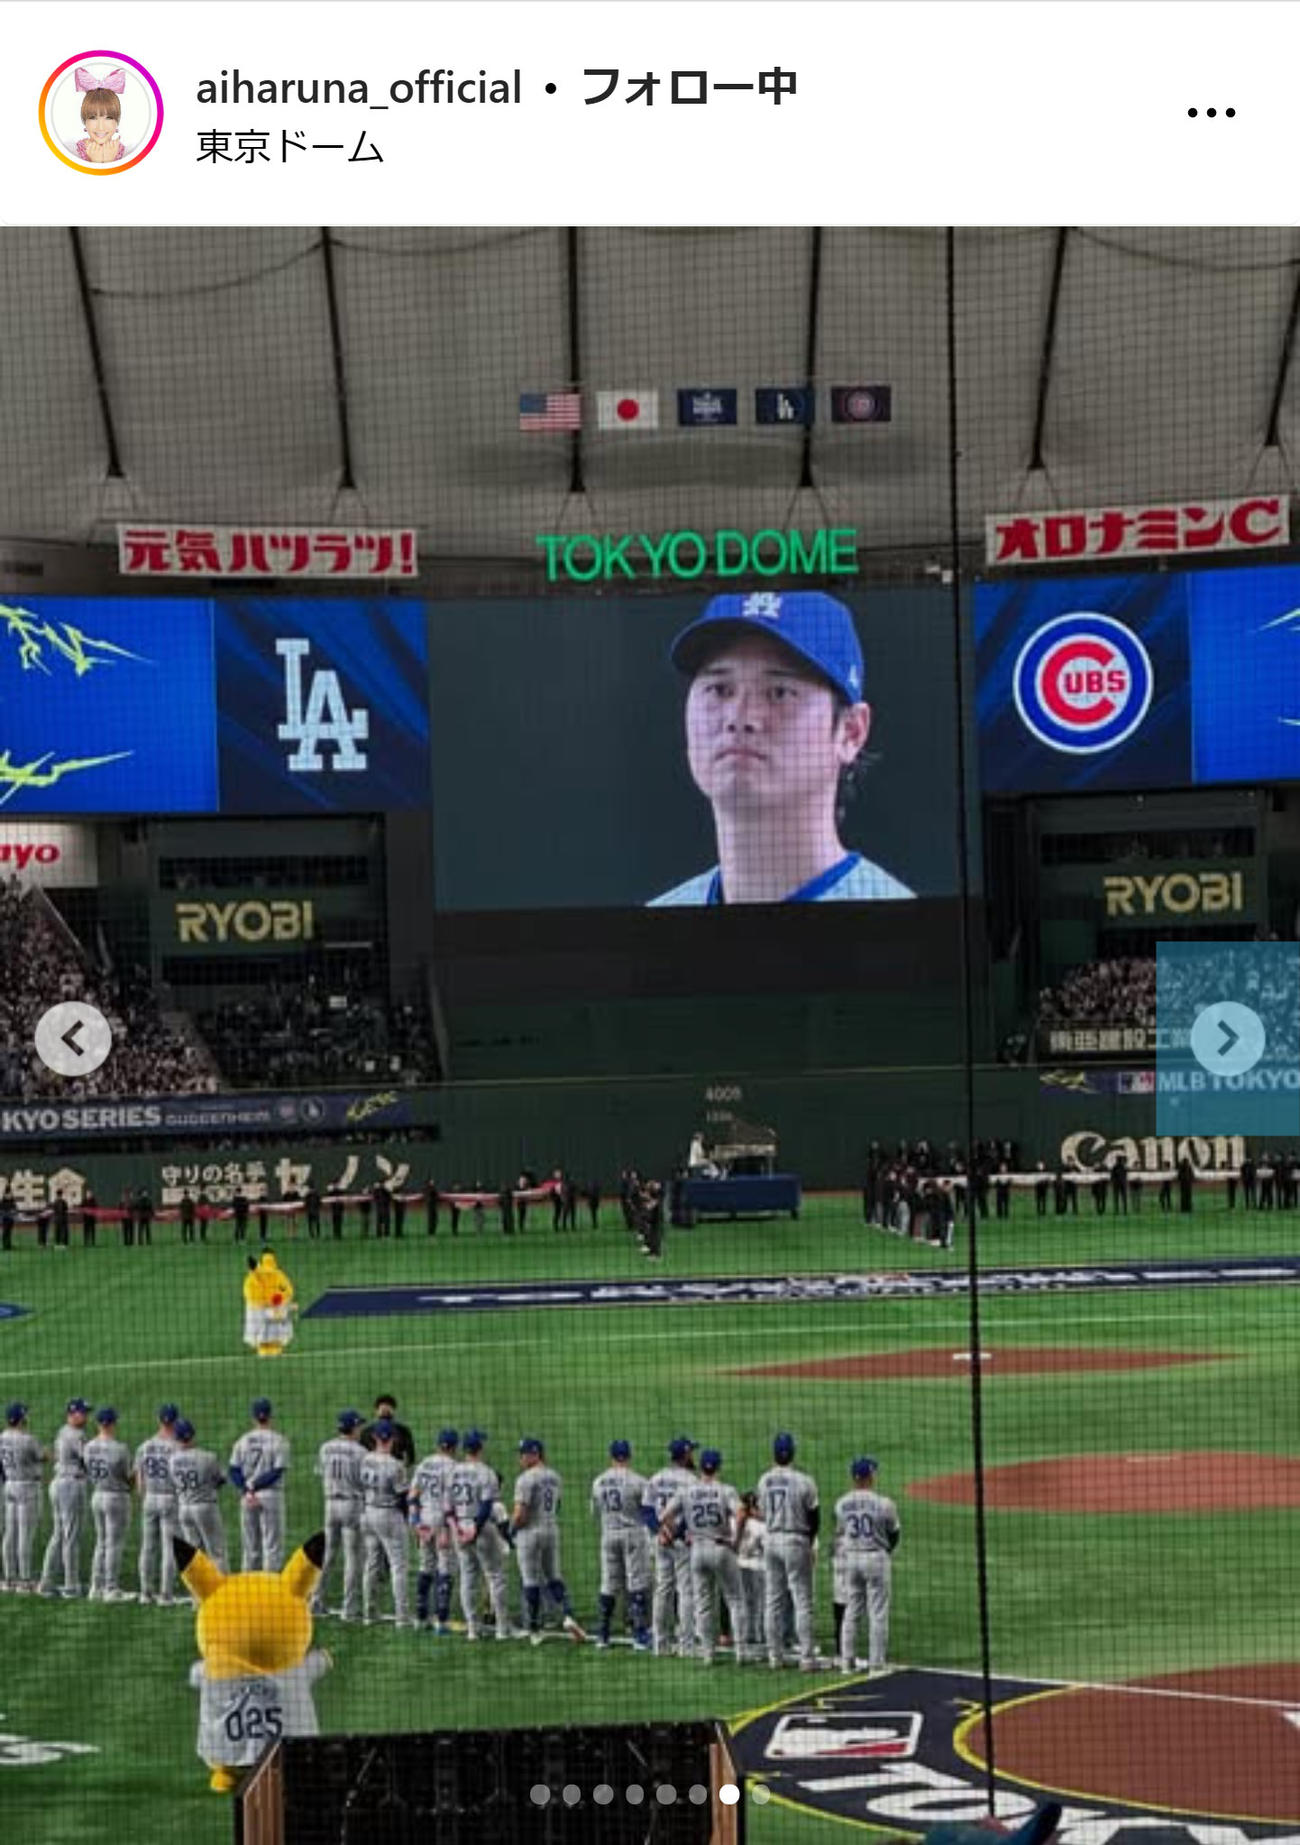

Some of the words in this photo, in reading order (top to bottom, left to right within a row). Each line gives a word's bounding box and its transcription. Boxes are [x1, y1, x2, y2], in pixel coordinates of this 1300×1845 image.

[996, 499, 1282, 560] オロナミンC
[123, 529, 414, 574] 元気ハツラツ!
[535, 530, 707, 581] TOKYO
[716, 528, 860, 576] DOME
[275, 637, 369, 772] LA
[1104, 871, 1243, 916] RYOBI
[176, 900, 314, 943] RYOBI
[1158, 1071, 1207, 1092] MLB
[1211, 1069, 1300, 1091] TOKYO
[62, 1106, 161, 1129] SERIES
[1061, 1131, 1246, 1172] Canon
[692, 1502, 721, 1528] 25
[846, 1512, 874, 1538] 30
